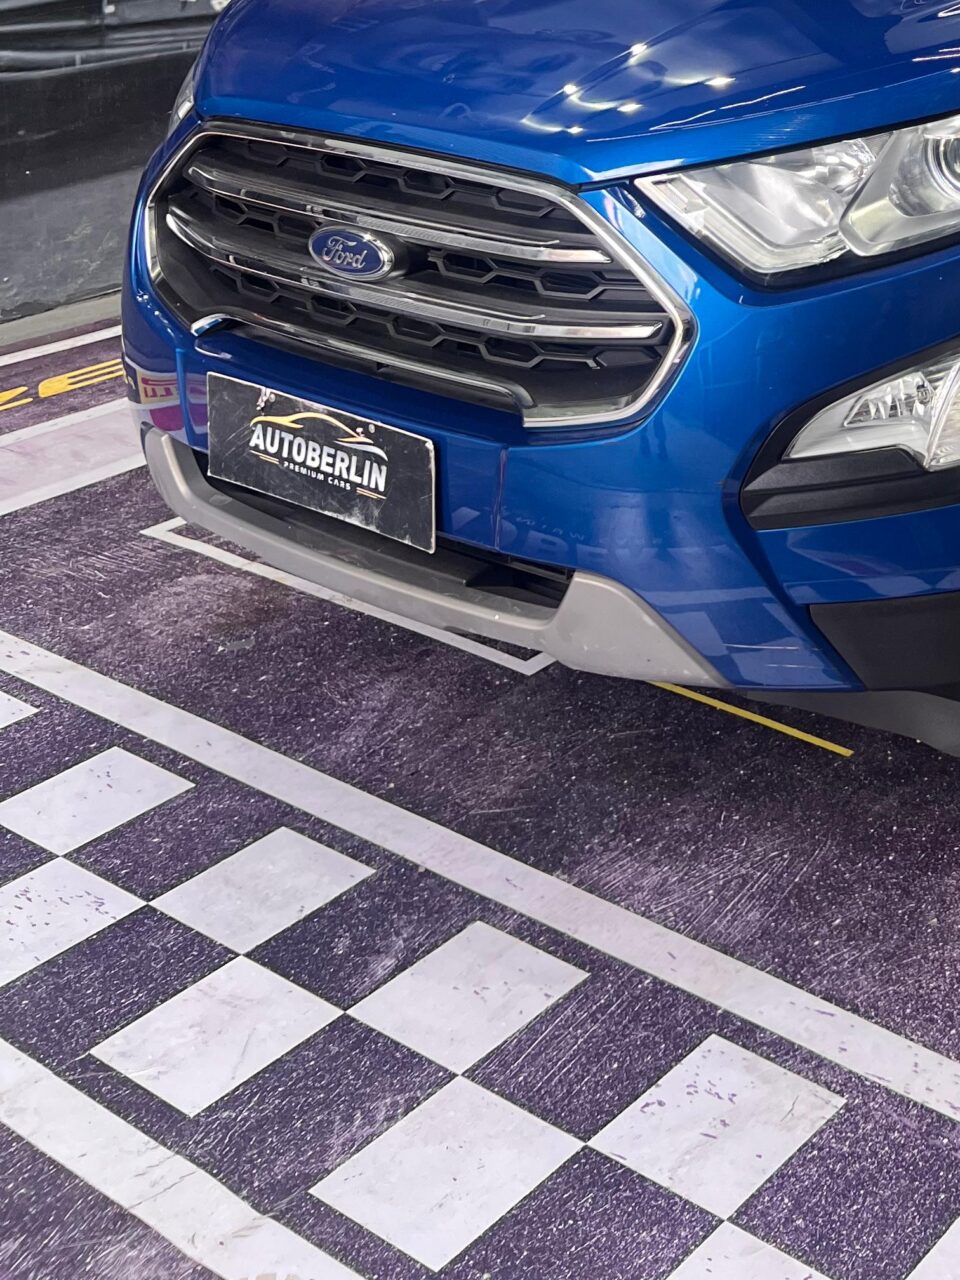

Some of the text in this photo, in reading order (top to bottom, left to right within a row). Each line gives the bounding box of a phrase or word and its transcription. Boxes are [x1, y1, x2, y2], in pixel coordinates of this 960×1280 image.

[322, 236, 367, 269] Ford
[249, 423, 388, 492] AUTOBERLIN
[284, 461, 351, 490] PREMIUM CARS
